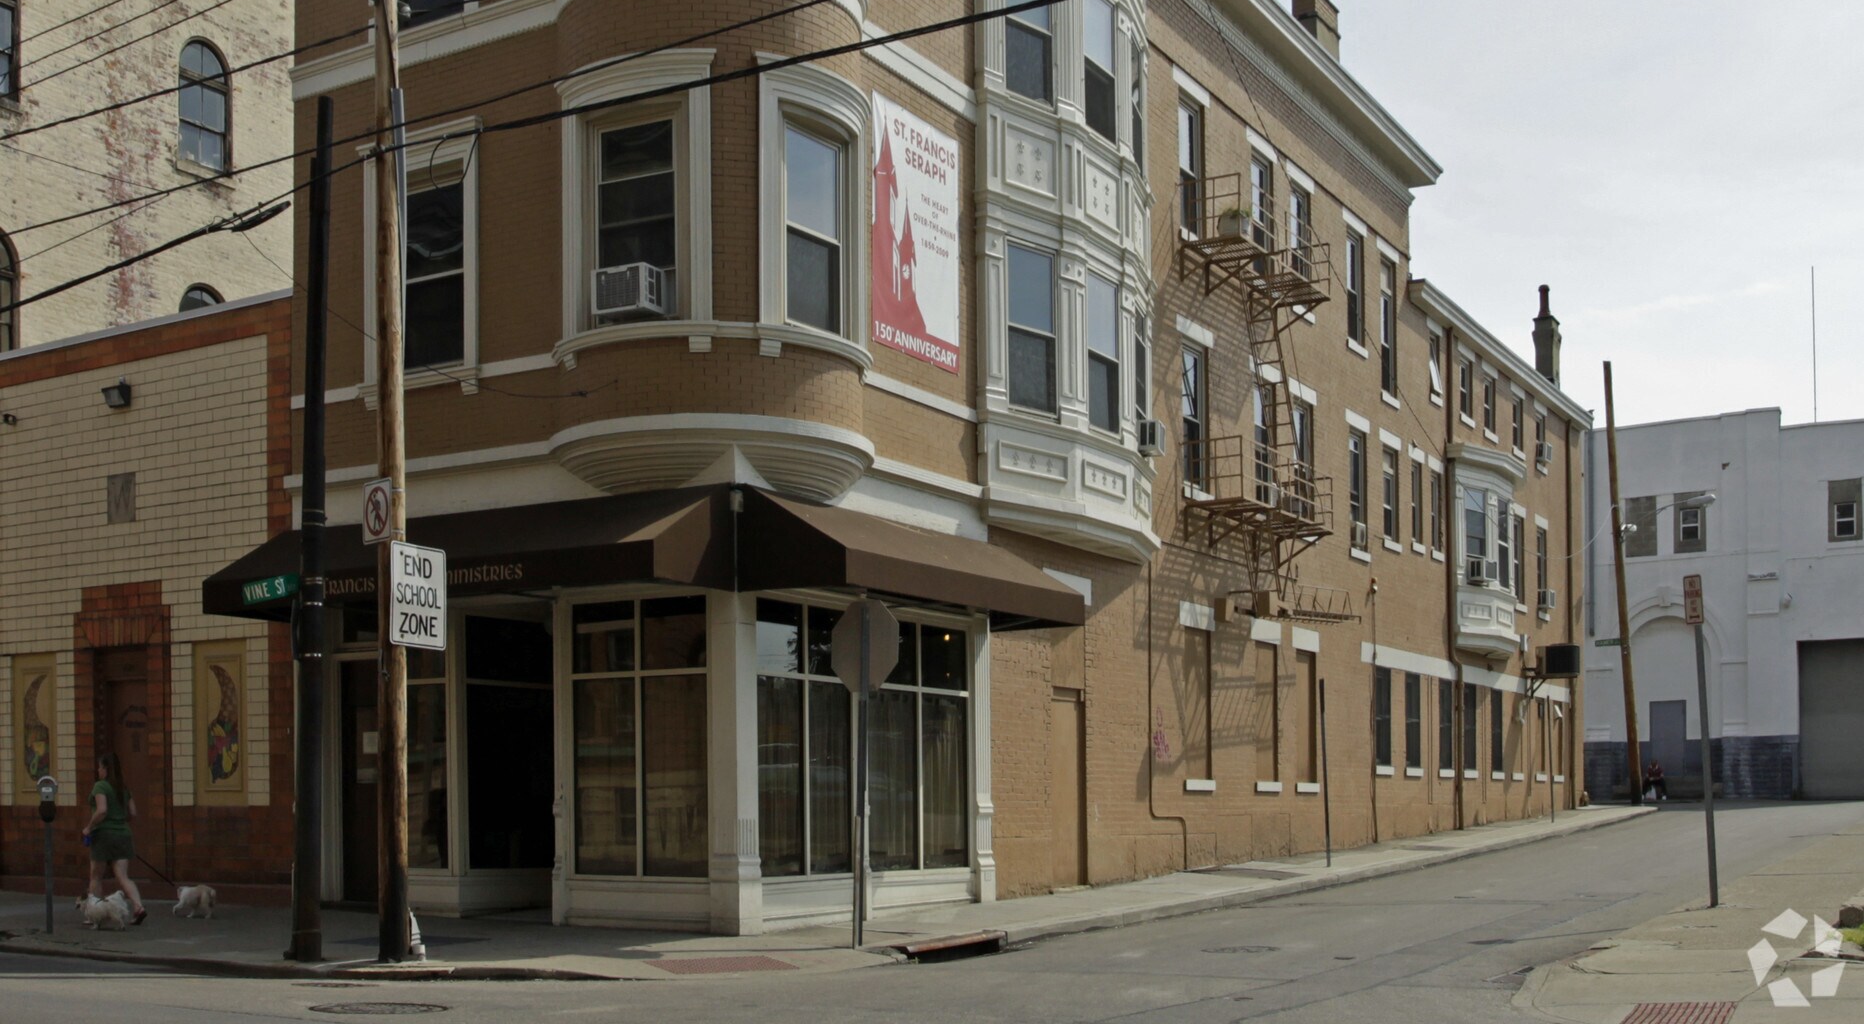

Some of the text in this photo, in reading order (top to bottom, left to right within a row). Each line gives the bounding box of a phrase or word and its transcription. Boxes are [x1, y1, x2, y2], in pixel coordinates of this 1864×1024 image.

[893, 118, 955, 170] ST. FRANCIS
[905, 147, 946, 186] SERAPH
[921, 193, 948, 216] THE HEART
[895, 329, 957, 367] ANNIVERSARY
[404, 554, 432, 579] END
[244, 582, 270, 601] VINE
[275, 578, 286, 595] ST
[396, 582, 441, 609] SCHOOL
[399, 612, 438, 638] ZONE
